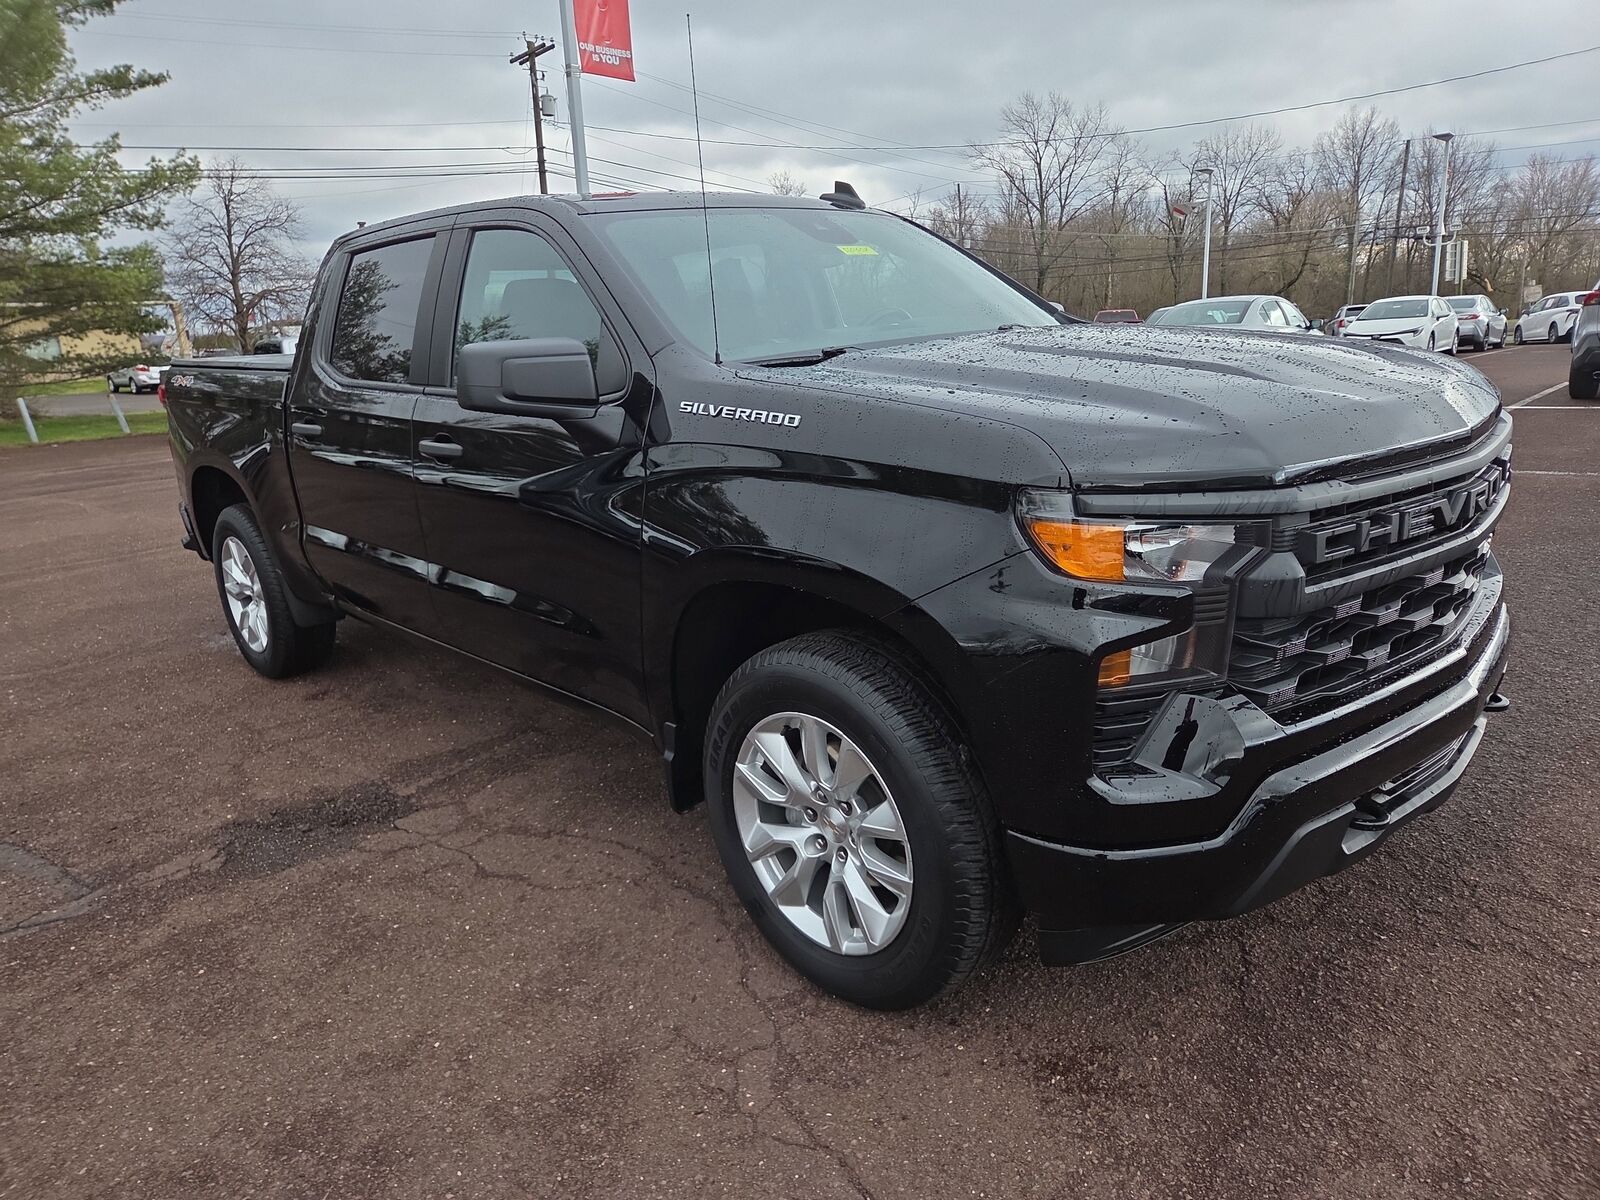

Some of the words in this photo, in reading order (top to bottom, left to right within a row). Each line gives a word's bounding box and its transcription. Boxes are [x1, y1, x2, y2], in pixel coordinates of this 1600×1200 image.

[579, 42, 594, 53] OUR
[596, 45, 631, 58] BUSINESS
[592, 53, 600, 62] IS
[600, 54, 620, 65] YOU
[679, 400, 802, 428] SILVERADO
